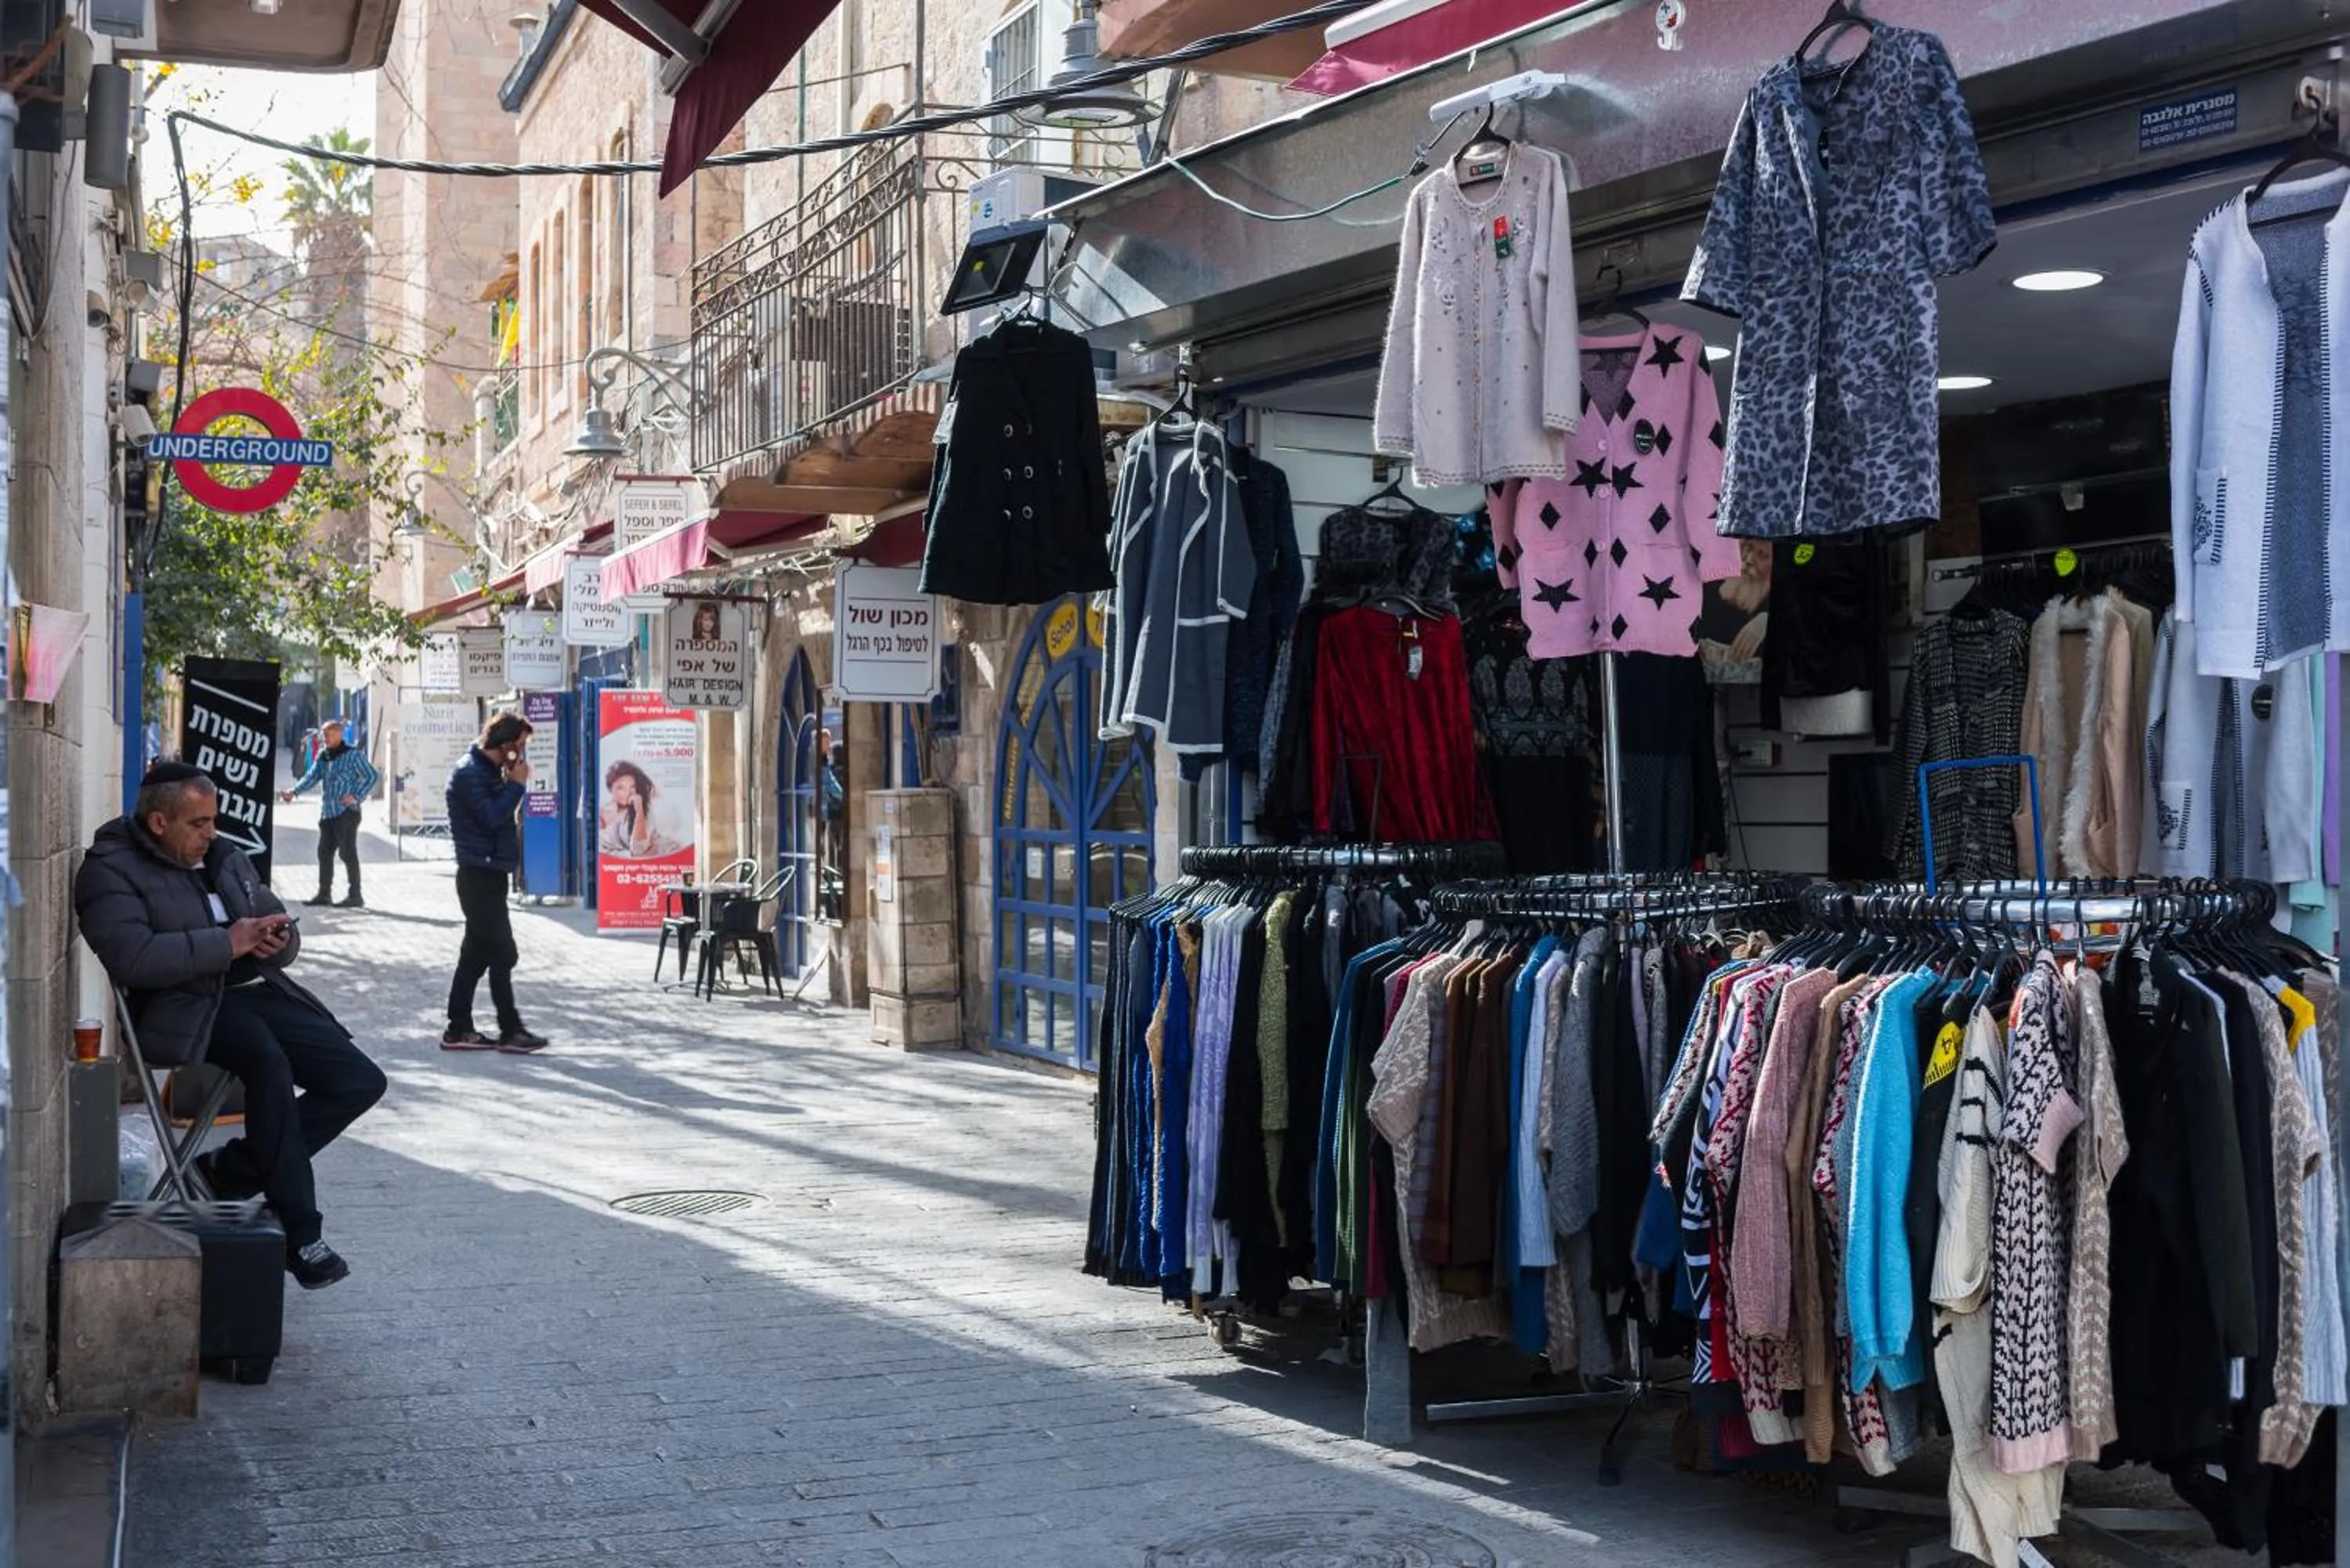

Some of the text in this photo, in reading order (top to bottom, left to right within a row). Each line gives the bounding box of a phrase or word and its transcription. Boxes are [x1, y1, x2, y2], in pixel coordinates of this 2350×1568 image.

[149, 435, 329, 463] UNDERGROUND
[624, 499, 649, 510] SEFER
[659, 499, 683, 510] SEFEL
[624, 514, 655, 527] וספל
[583, 616, 615, 628] ולייזר
[848, 605, 928, 628] מכון שול
[675, 638, 738, 652] המספרה
[847, 633, 928, 656] לטיפול בכף הרגל
[678, 659, 736, 673] של אפי
[668, 677, 743, 691] HAIR DESIGN
[423, 706, 454, 720] Nurit
[189, 704, 269, 760] מספרת
[405, 720, 474, 735] cosmetics
[196, 745, 259, 789] נשים
[216, 786, 266, 827] וגבר
